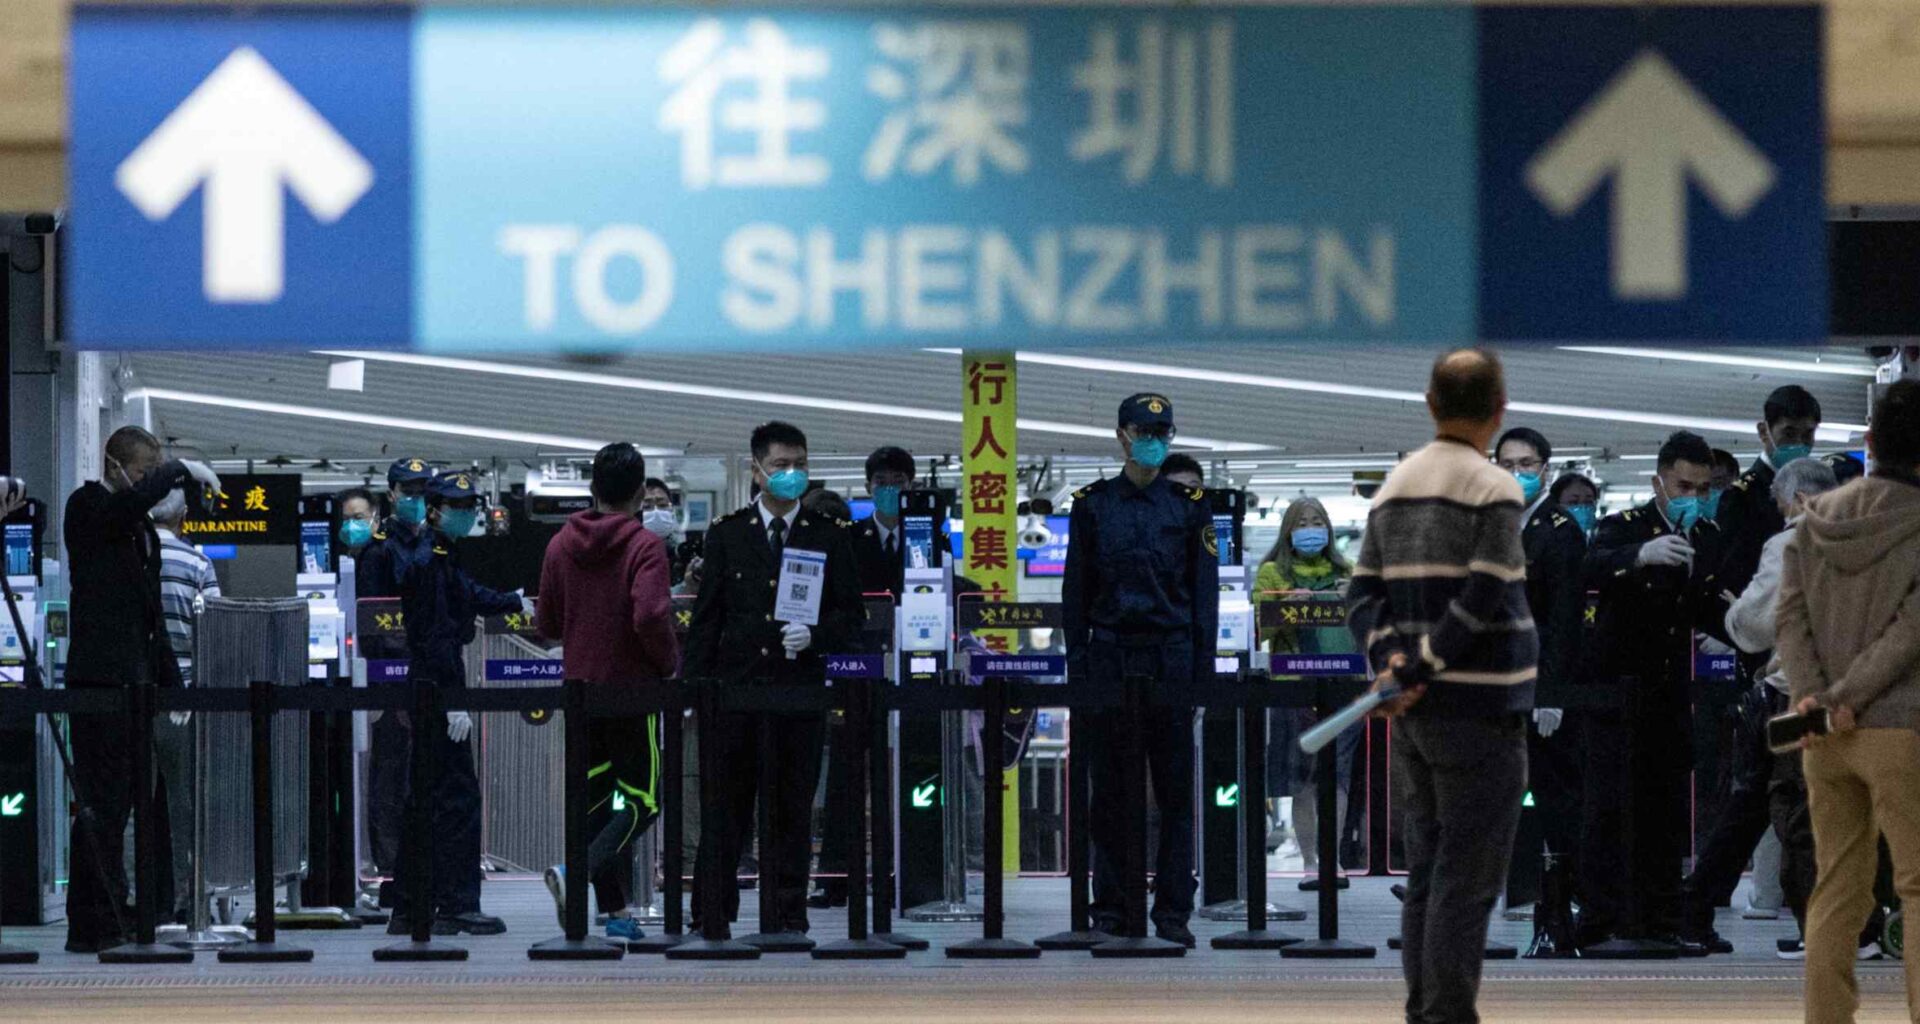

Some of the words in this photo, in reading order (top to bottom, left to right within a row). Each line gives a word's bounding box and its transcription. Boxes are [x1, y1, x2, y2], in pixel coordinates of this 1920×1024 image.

[657, 18, 1235, 188] 往深圳
[500, 222, 674, 335] TO
[719, 222, 1397, 333] SHENZHEN
[182, 521, 267, 534] QUARANTINE
